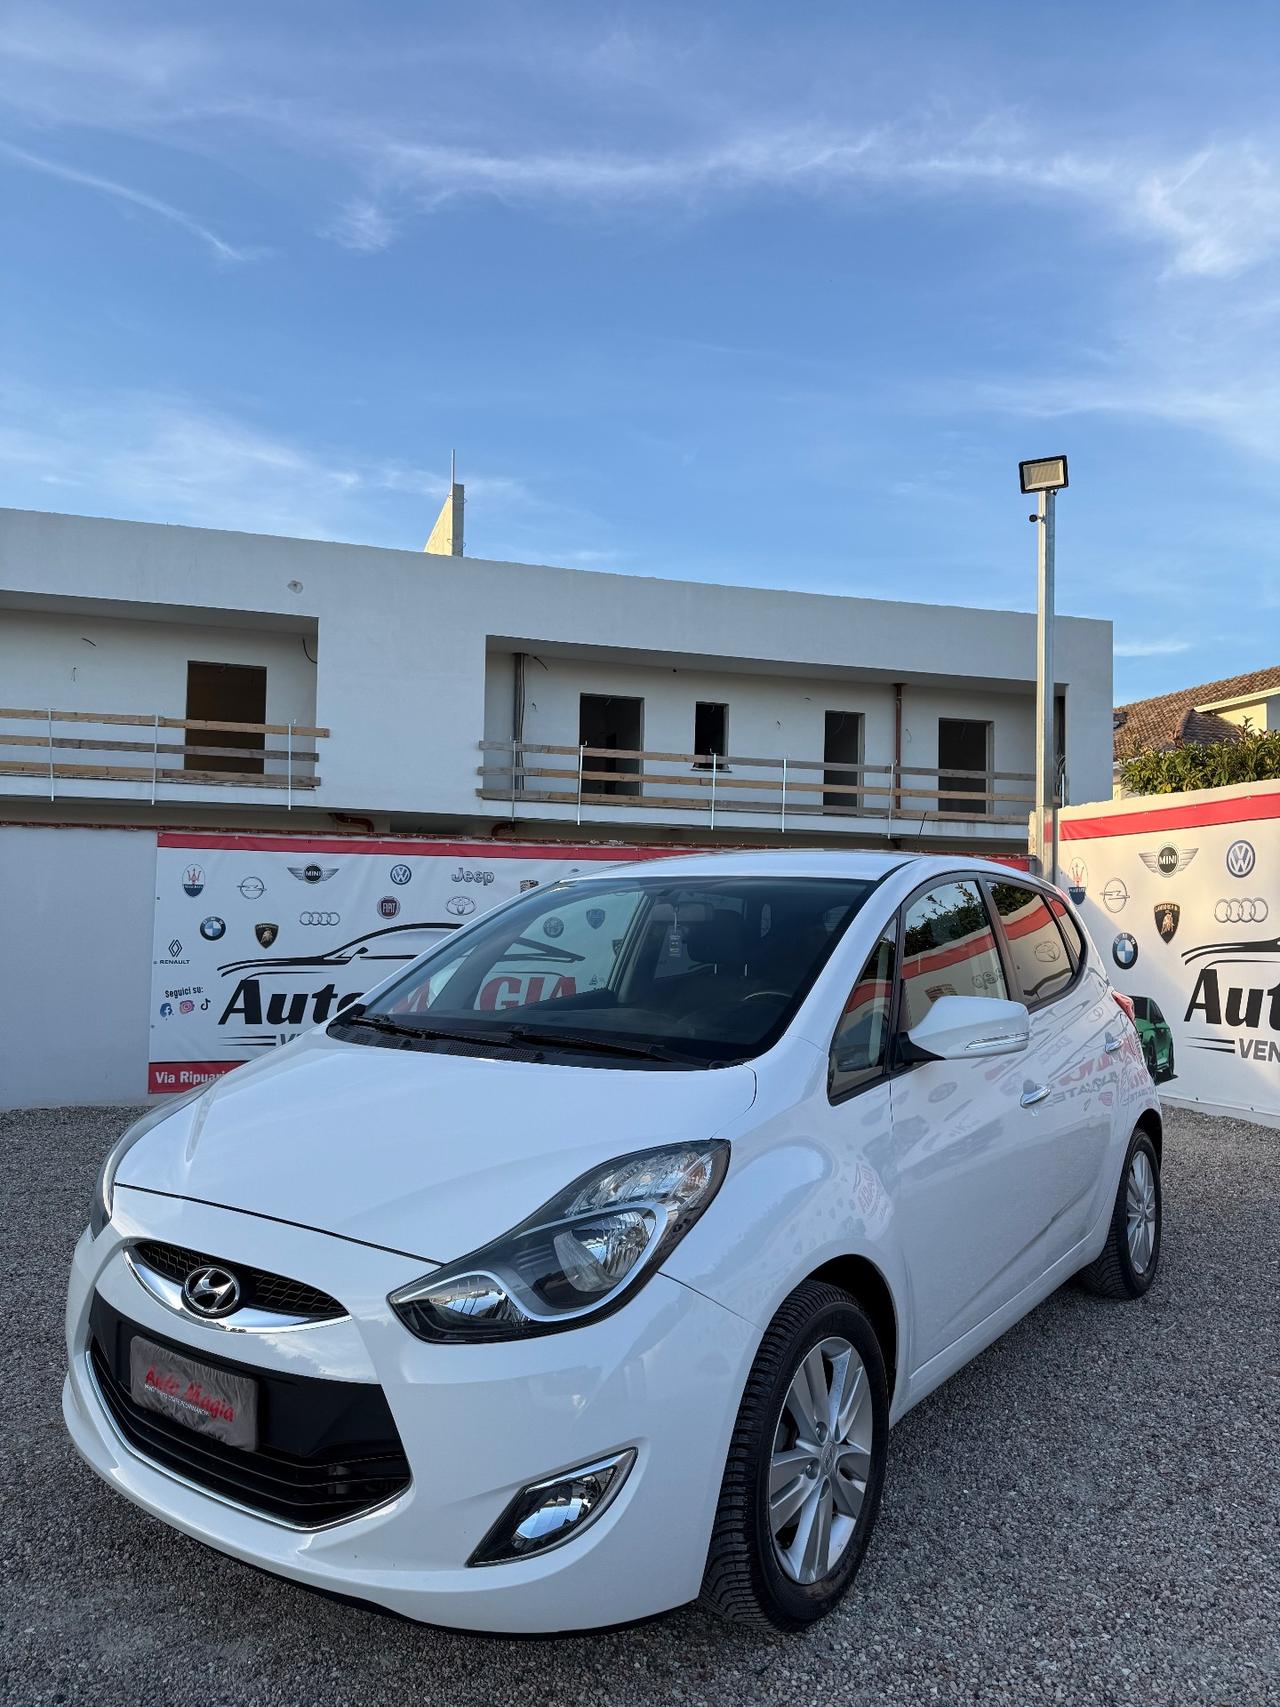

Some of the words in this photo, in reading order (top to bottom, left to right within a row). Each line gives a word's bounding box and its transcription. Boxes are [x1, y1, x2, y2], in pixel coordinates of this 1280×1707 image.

[1159, 854, 1177, 865] MINI
[451, 867, 495, 886] Jeep
[383, 902, 396, 913] FIAT
[164, 986, 191, 999] Seguici
[392, 976, 577, 1014] MGIA
[155, 1071, 176, 1084] Via
